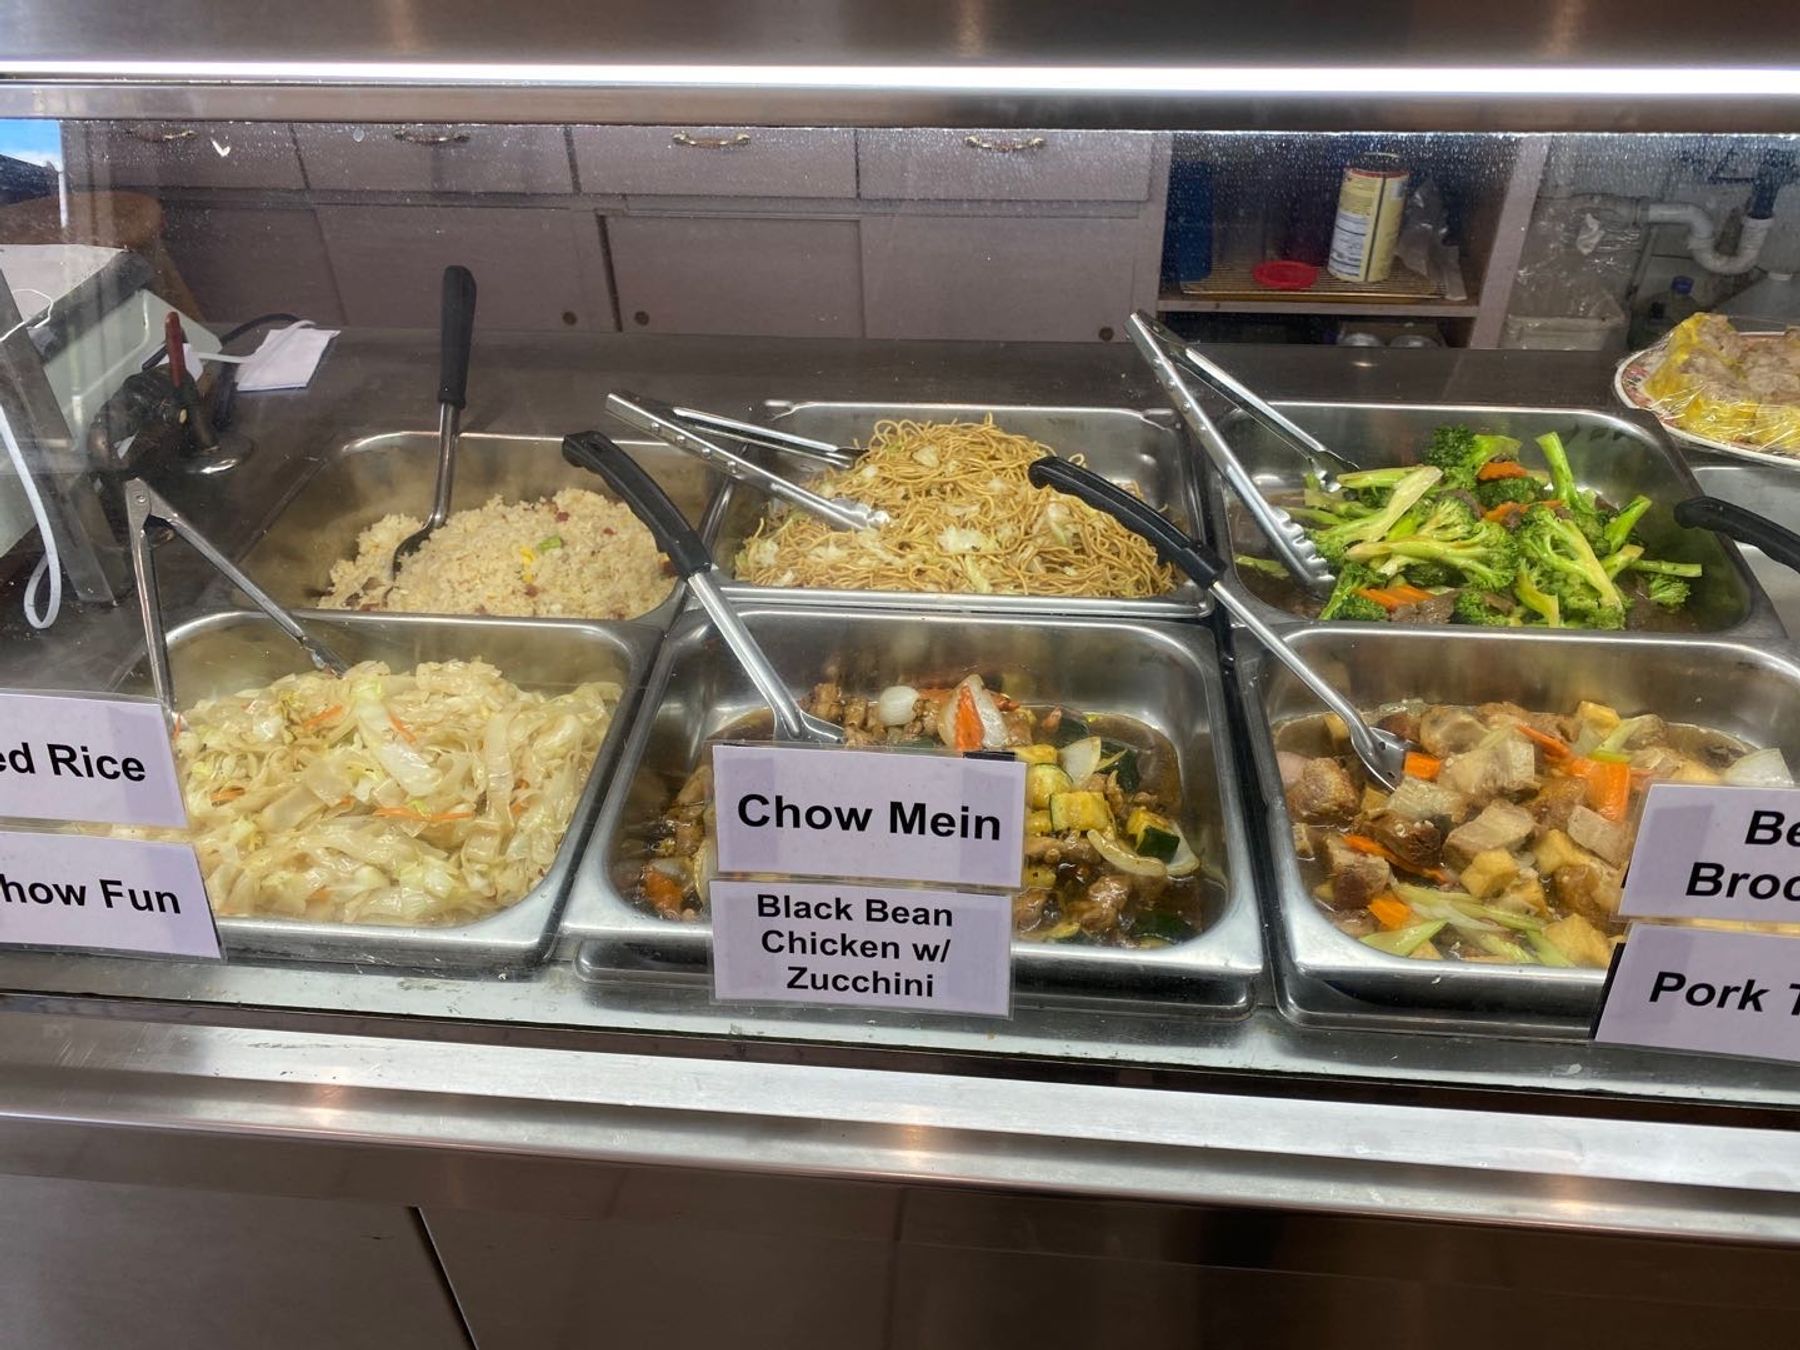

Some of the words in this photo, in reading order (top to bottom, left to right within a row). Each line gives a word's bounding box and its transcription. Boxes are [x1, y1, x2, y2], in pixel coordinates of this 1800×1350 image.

[47, 743, 146, 782] Rice
[737, 793, 873, 832] Chow
[889, 801, 1001, 841] Mein
[99, 878, 181, 915] Fun
[757, 893, 854, 921] Black
[865, 898, 953, 927] Bean
[761, 929, 900, 960] Chicken
[911, 938, 952, 963] w/
[786, 966, 934, 998] Zucchini
[1648, 970, 1770, 1013] Pork
